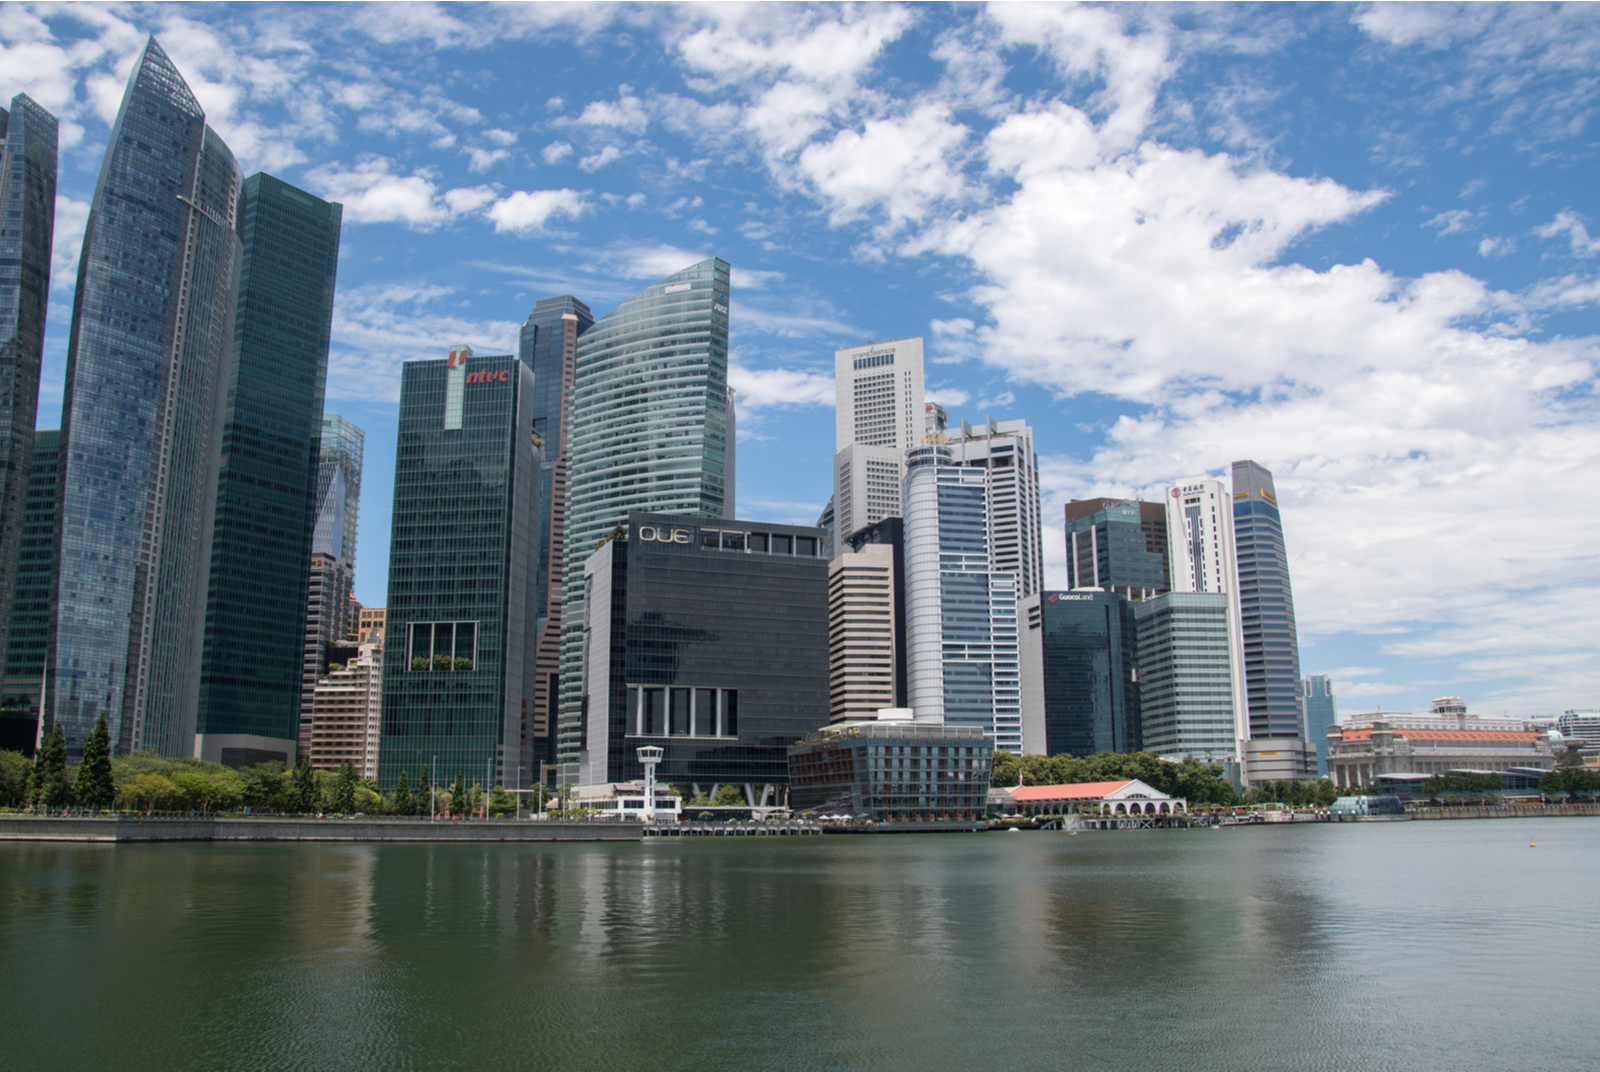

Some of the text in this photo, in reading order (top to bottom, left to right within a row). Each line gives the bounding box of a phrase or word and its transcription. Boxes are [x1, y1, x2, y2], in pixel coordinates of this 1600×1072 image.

[466, 368, 509, 384] ntuc
[639, 526, 690, 544] OUE
[1058, 593, 1094, 601] GuocoLand
